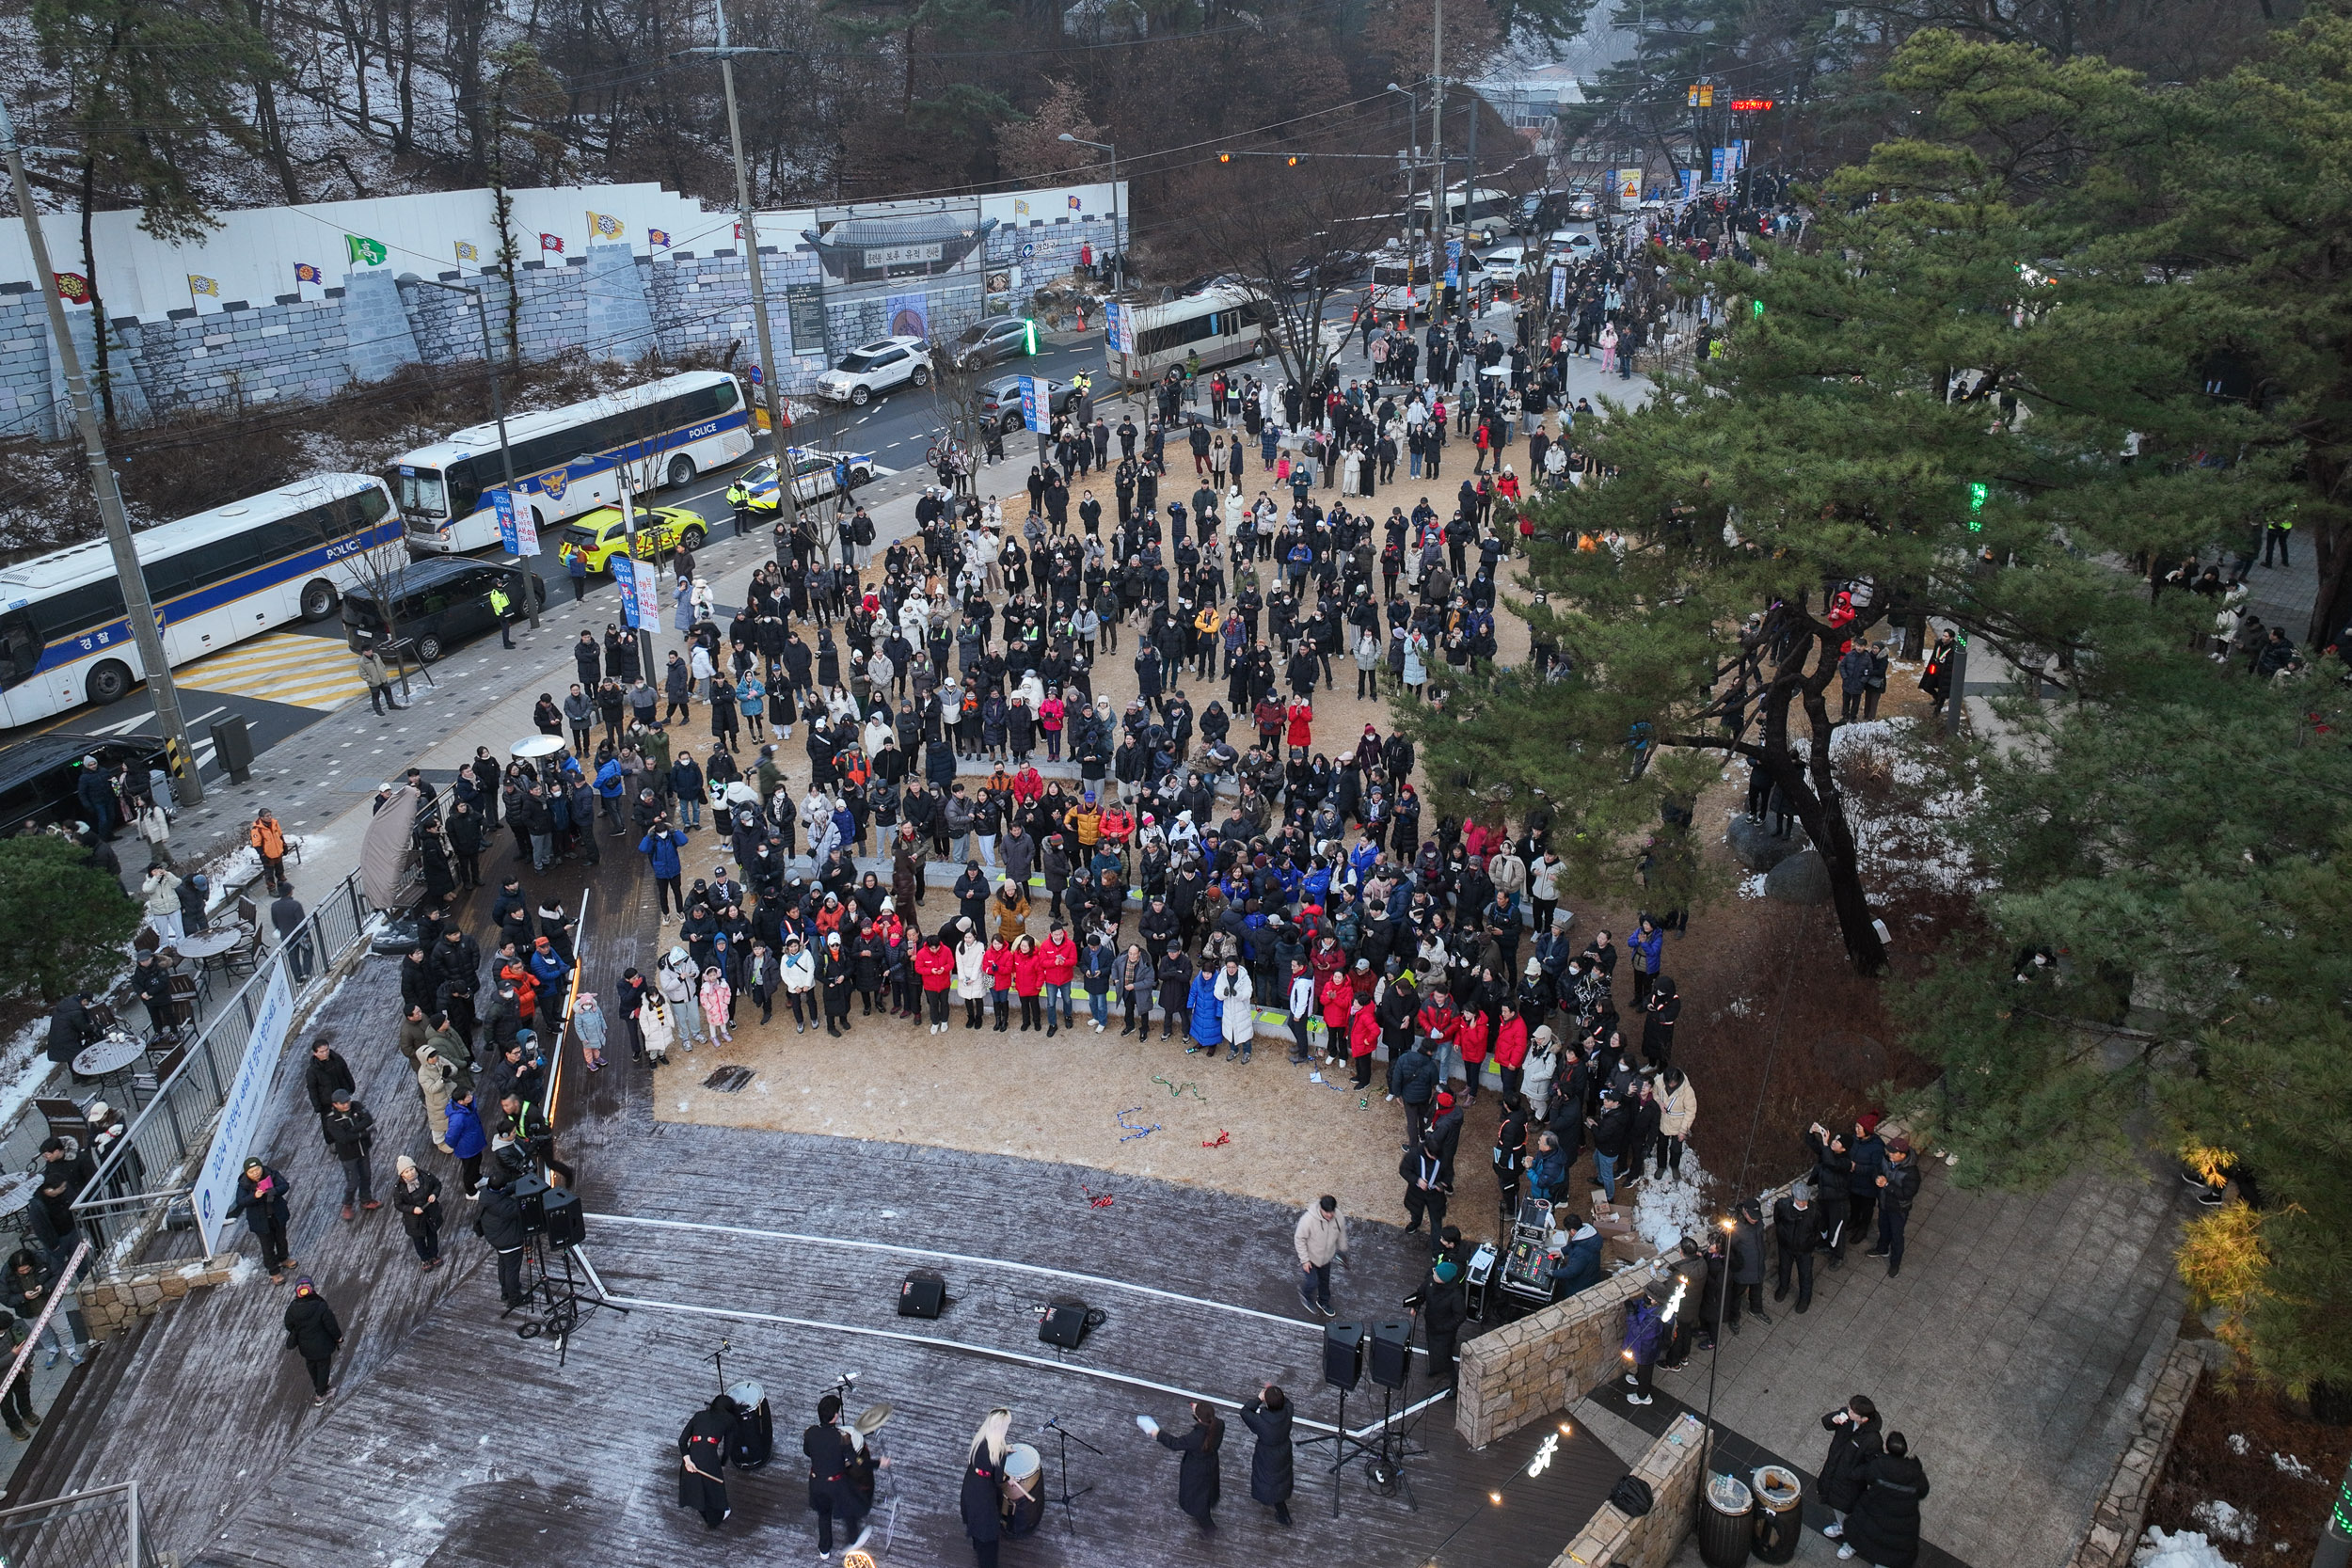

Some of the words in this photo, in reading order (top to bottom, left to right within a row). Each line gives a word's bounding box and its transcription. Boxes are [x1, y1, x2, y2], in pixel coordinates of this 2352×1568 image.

[885, 250, 900, 261] 보루
[905, 248, 920, 260] 유적
[689, 422, 717, 439] POLICE
[638, 577, 652, 591] 행복
[80, 631, 110, 650] 경찰
[213, 1138, 227, 1180] 2024
[241, 1072, 250, 1103] 새해
[247, 1057, 255, 1079] 복
[252, 1037, 262, 1067] 많이
[261, 998, 276, 1041] 받으세요
